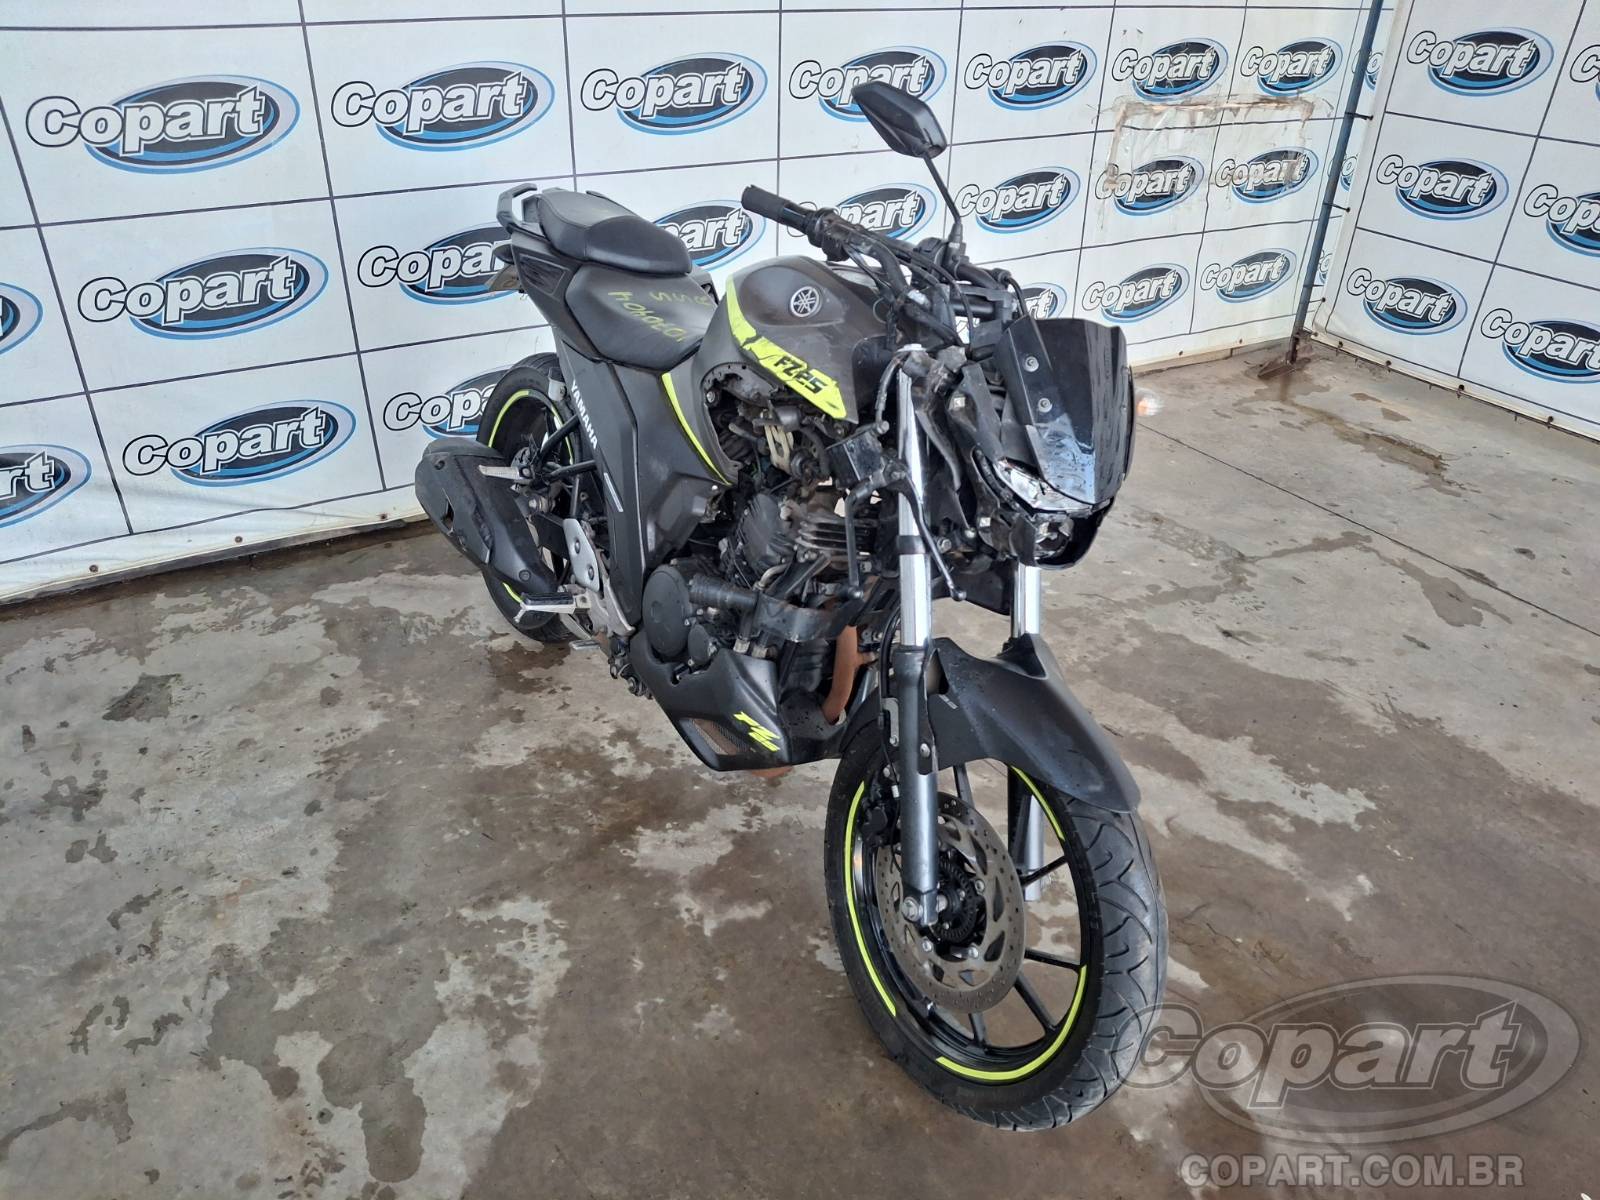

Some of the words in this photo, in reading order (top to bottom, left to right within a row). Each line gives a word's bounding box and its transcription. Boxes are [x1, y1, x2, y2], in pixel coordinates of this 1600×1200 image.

[964, 47, 1084, 89] Copart
[1112, 47, 1218, 90] Copart
[1240, 44, 1329, 86] Copart
[1407, 30, 1538, 77] Copart
[331, 71, 528, 133] Copart
[581, 60, 742, 118] Copart
[26, 86, 267, 155] Copart
[955, 173, 1069, 218] Copart
[1095, 162, 1195, 204] Copart
[1215, 152, 1309, 194] Copart
[1376, 155, 1495, 204] Copart
[1523, 184, 1600, 234] Cop
[358, 239, 512, 292] Copa
[1082, 267, 1180, 310] Copart
[1200, 254, 1287, 294] Copart
[77, 256, 297, 325] Copart
[1346, 268, 1455, 322] Copart
[773, 355, 828, 394] FZ25
[383, 384, 497, 431] Cop
[570, 379, 598, 450] YAMAHA
[123, 406, 327, 475] Copart
